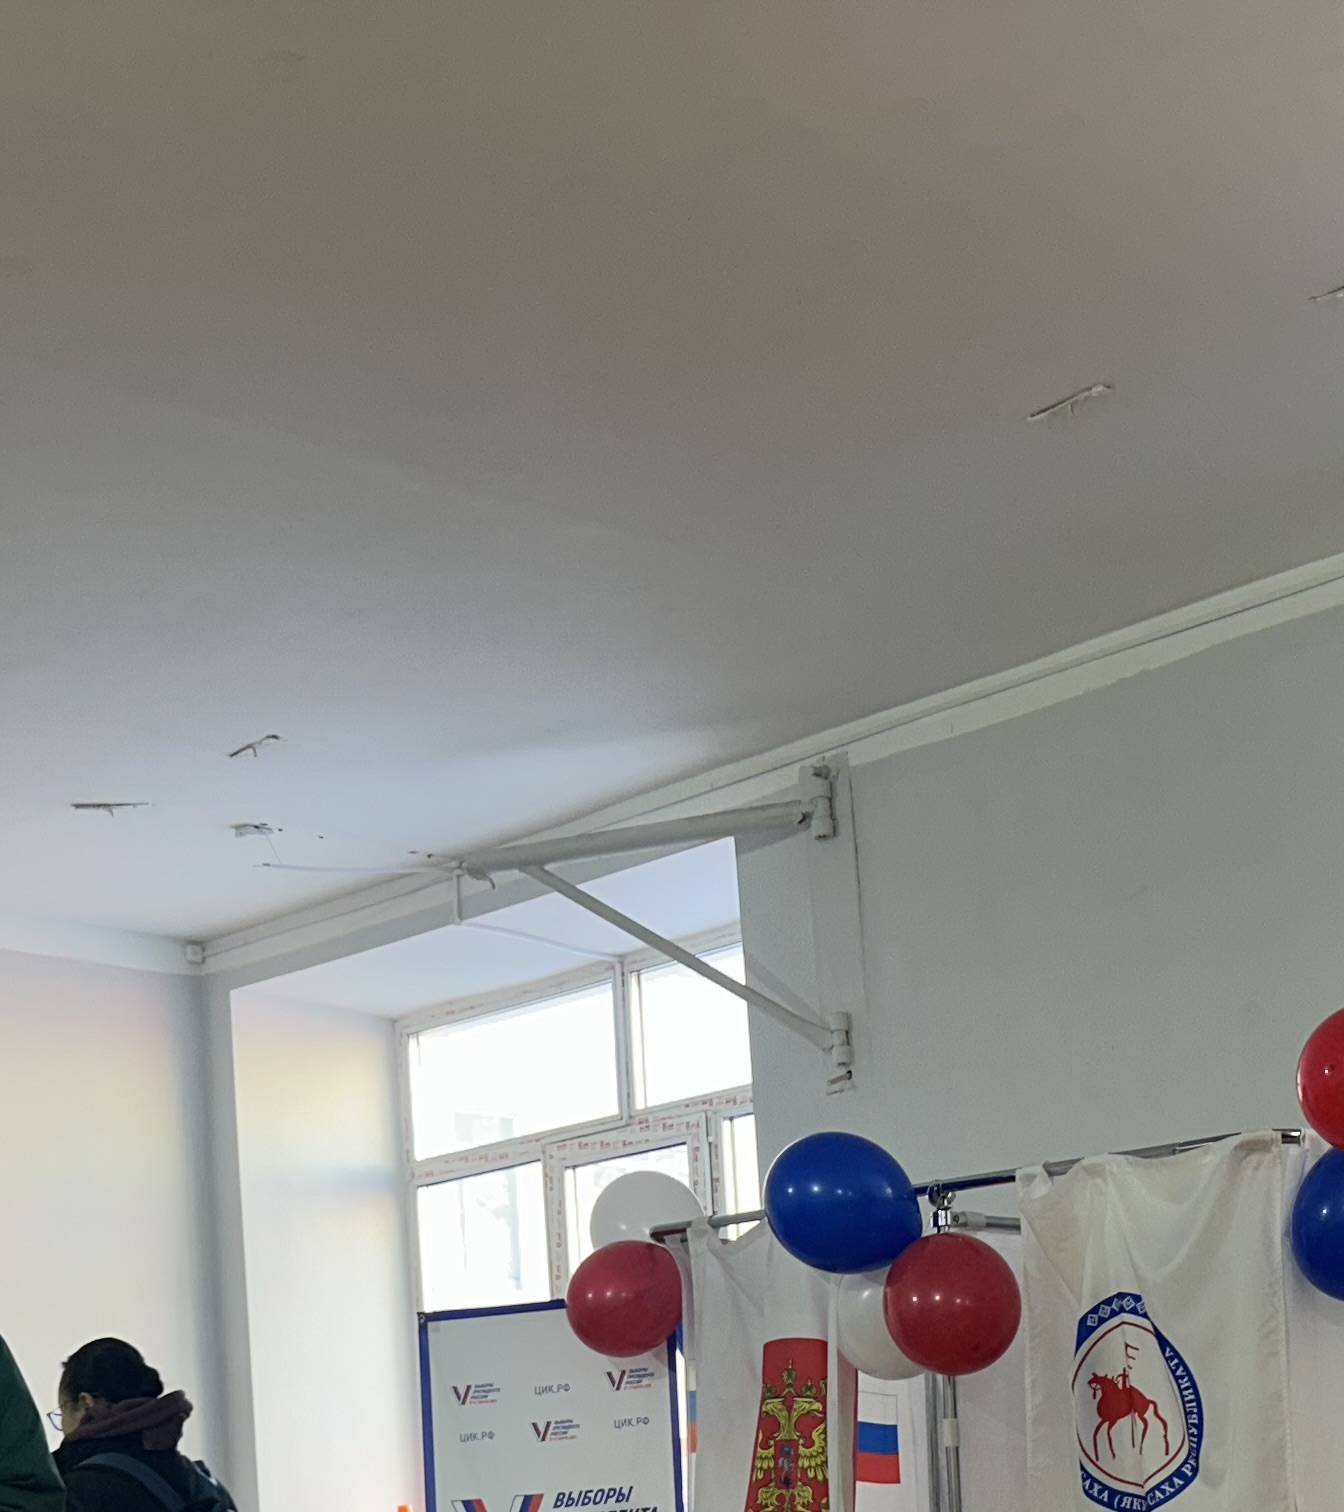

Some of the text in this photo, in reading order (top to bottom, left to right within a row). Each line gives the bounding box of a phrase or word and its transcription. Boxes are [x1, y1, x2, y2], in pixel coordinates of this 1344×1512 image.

[535, 1384, 571, 1396] ЦИК.РФ
[614, 1417, 650, 1429] ЦИК.РФ
[460, 1431, 495, 1442] ЦИК.РФ
[553, 1485, 633, 1509] ВЫБОРЫ
